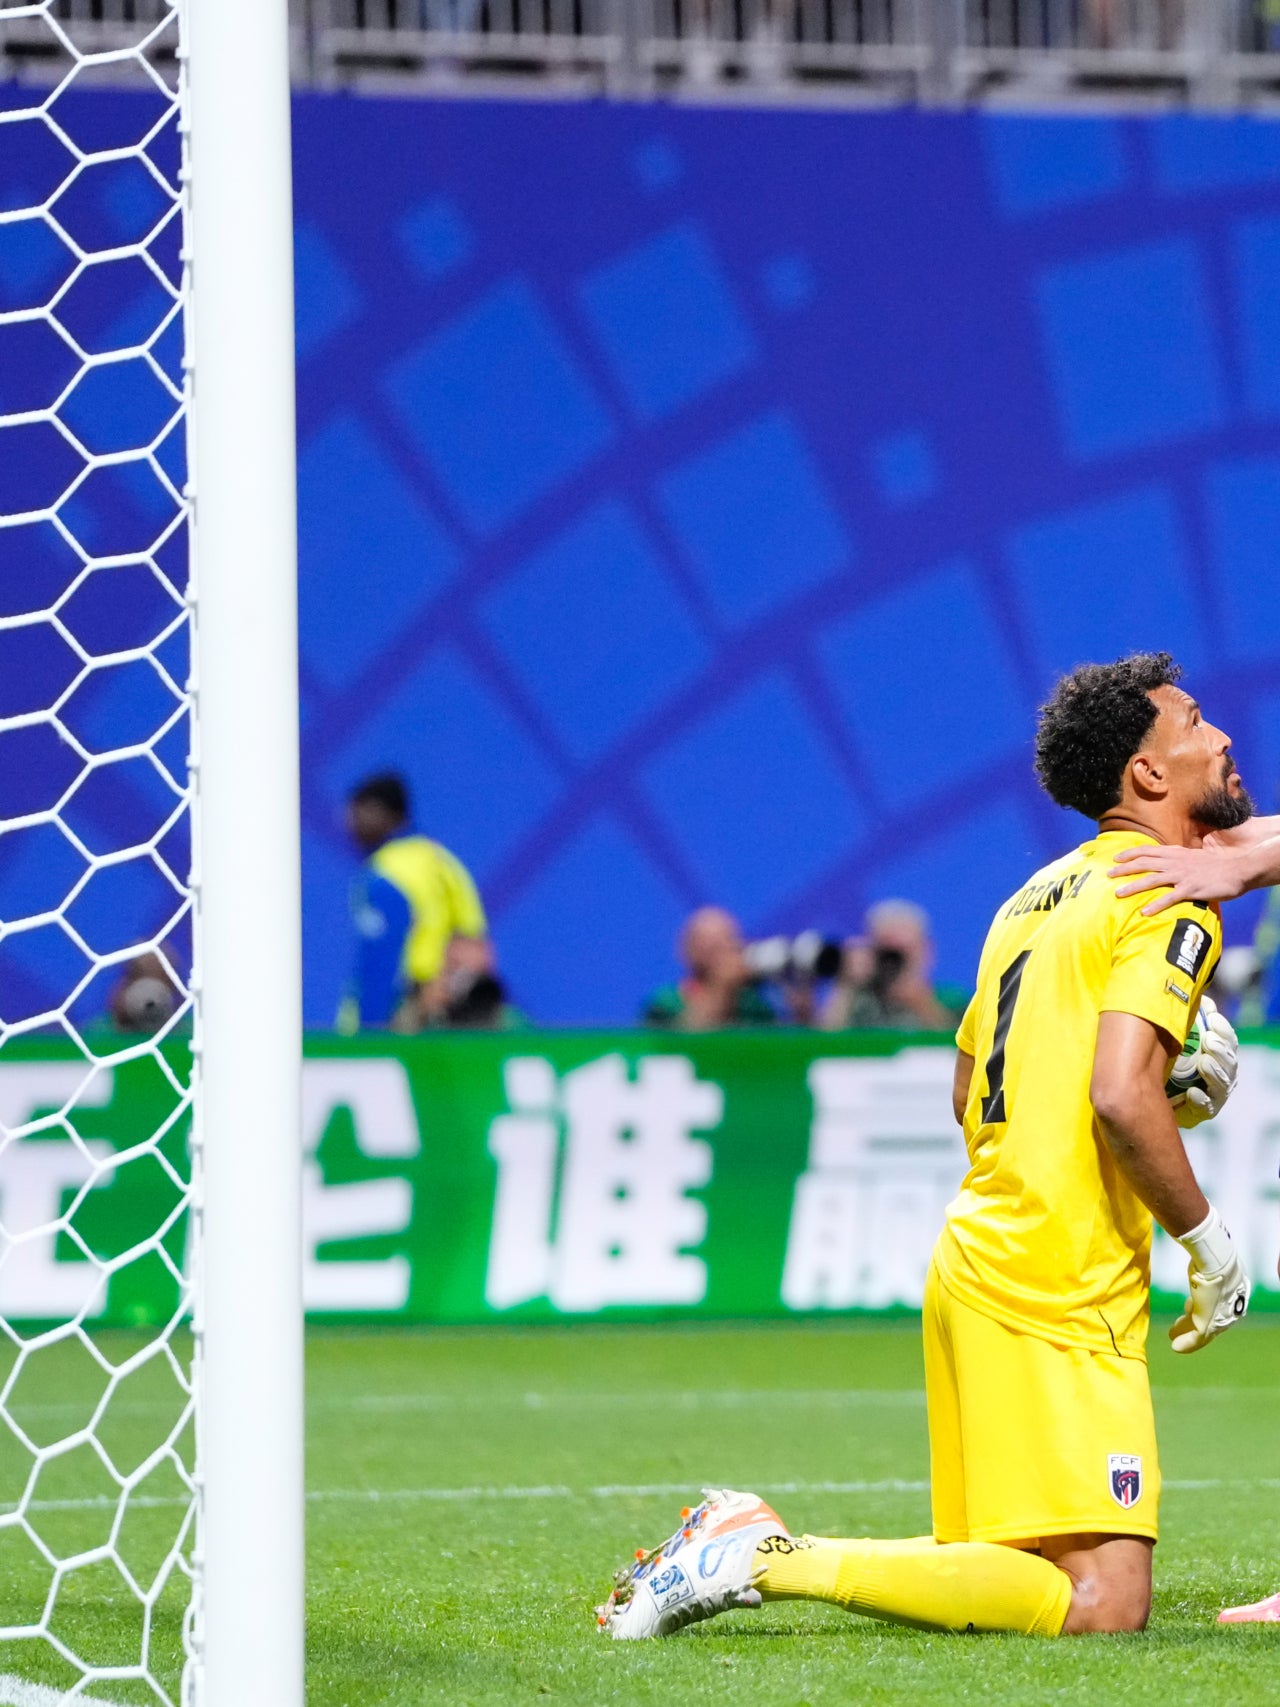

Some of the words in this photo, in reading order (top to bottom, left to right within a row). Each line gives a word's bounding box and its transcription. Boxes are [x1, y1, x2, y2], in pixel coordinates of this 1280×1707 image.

[1004, 870, 1092, 921] OZINA
[981, 949, 1033, 1123] 1
[1110, 1456, 1139, 1465] FCF
